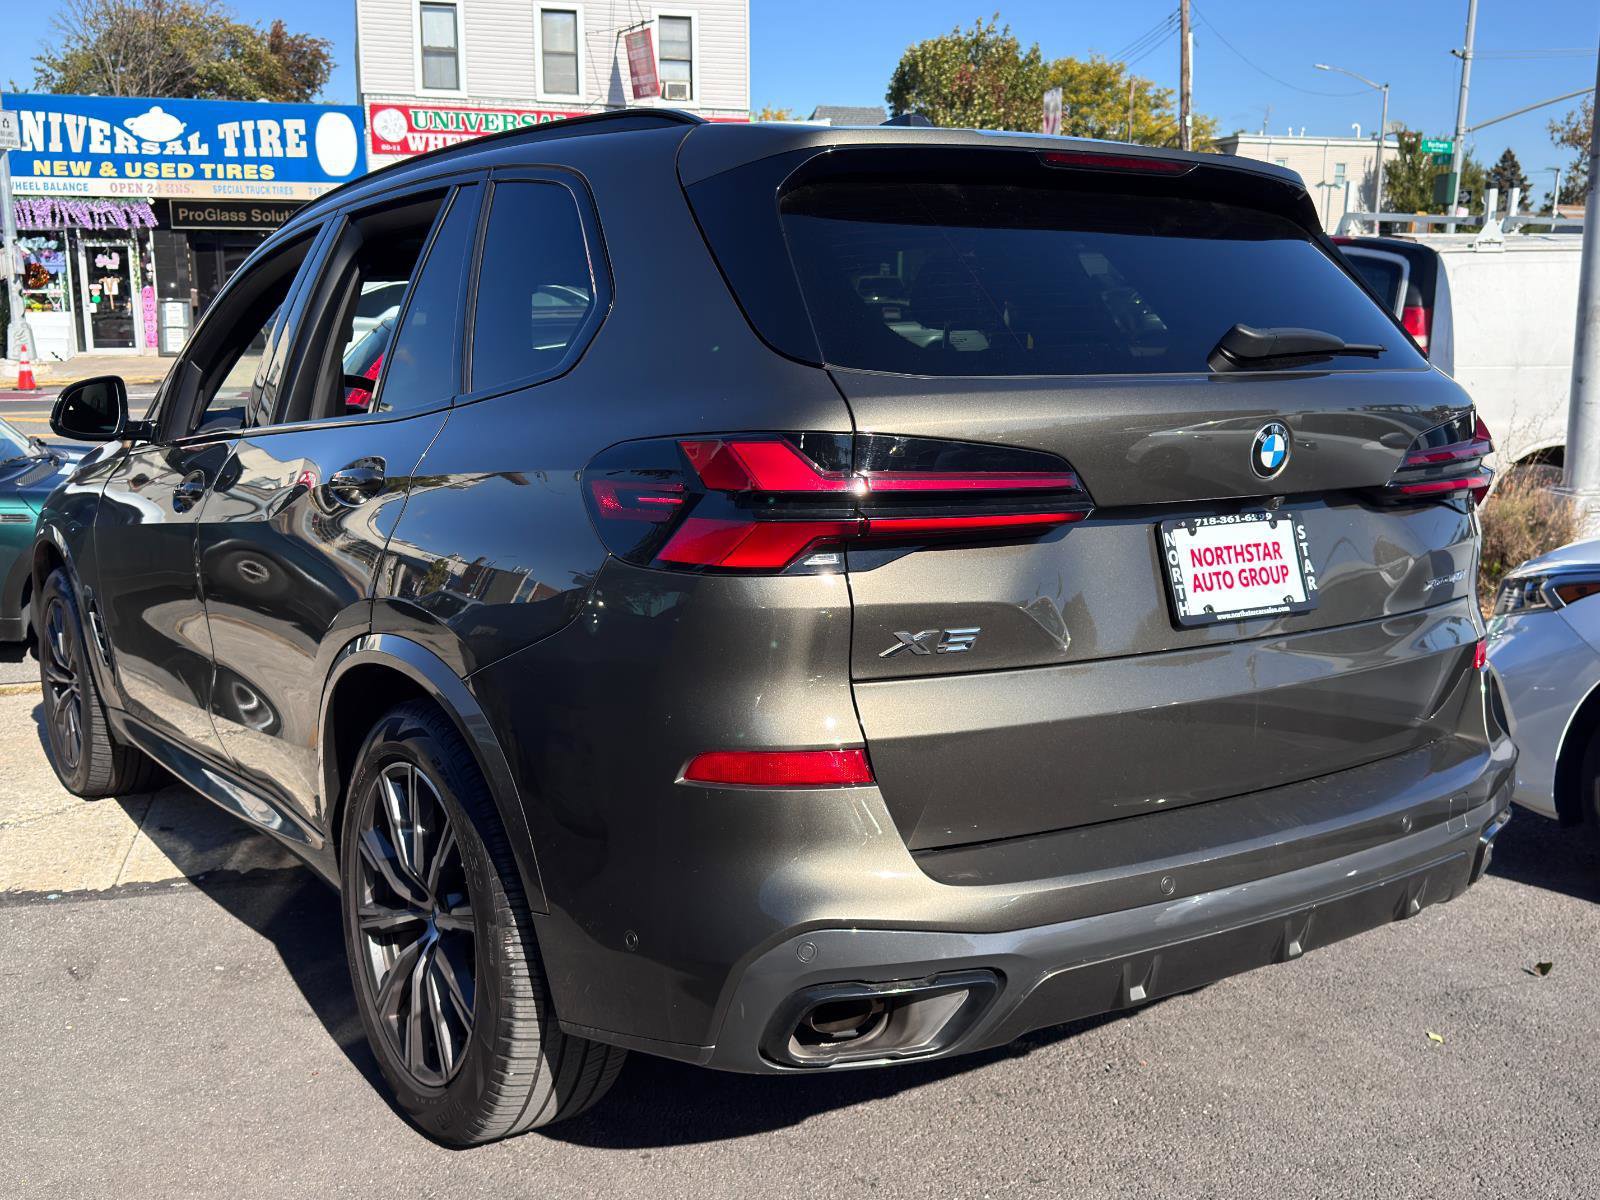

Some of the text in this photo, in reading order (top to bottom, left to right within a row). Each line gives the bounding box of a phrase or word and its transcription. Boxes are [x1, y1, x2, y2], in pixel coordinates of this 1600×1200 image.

[18, 110, 209, 155] NIVERSAL
[217, 119, 308, 158] TIRE
[33, 160, 275, 180] NEW & USED TIRES
[12, 181, 89, 192] HEEL BALANCE
[110, 183, 144, 193] OPEN
[213, 185, 244, 195] SPECIAL
[273, 186, 294, 195] TIRES
[178, 208, 247, 222] ProGlass
[1190, 541, 1283, 568] NORTHSTAR
[1296, 524, 1319, 591] STAR
[1164, 532, 1189, 616] NORTH
[1193, 564, 1290, 593] AUTO GROUP
[878, 626, 981, 658] X5
